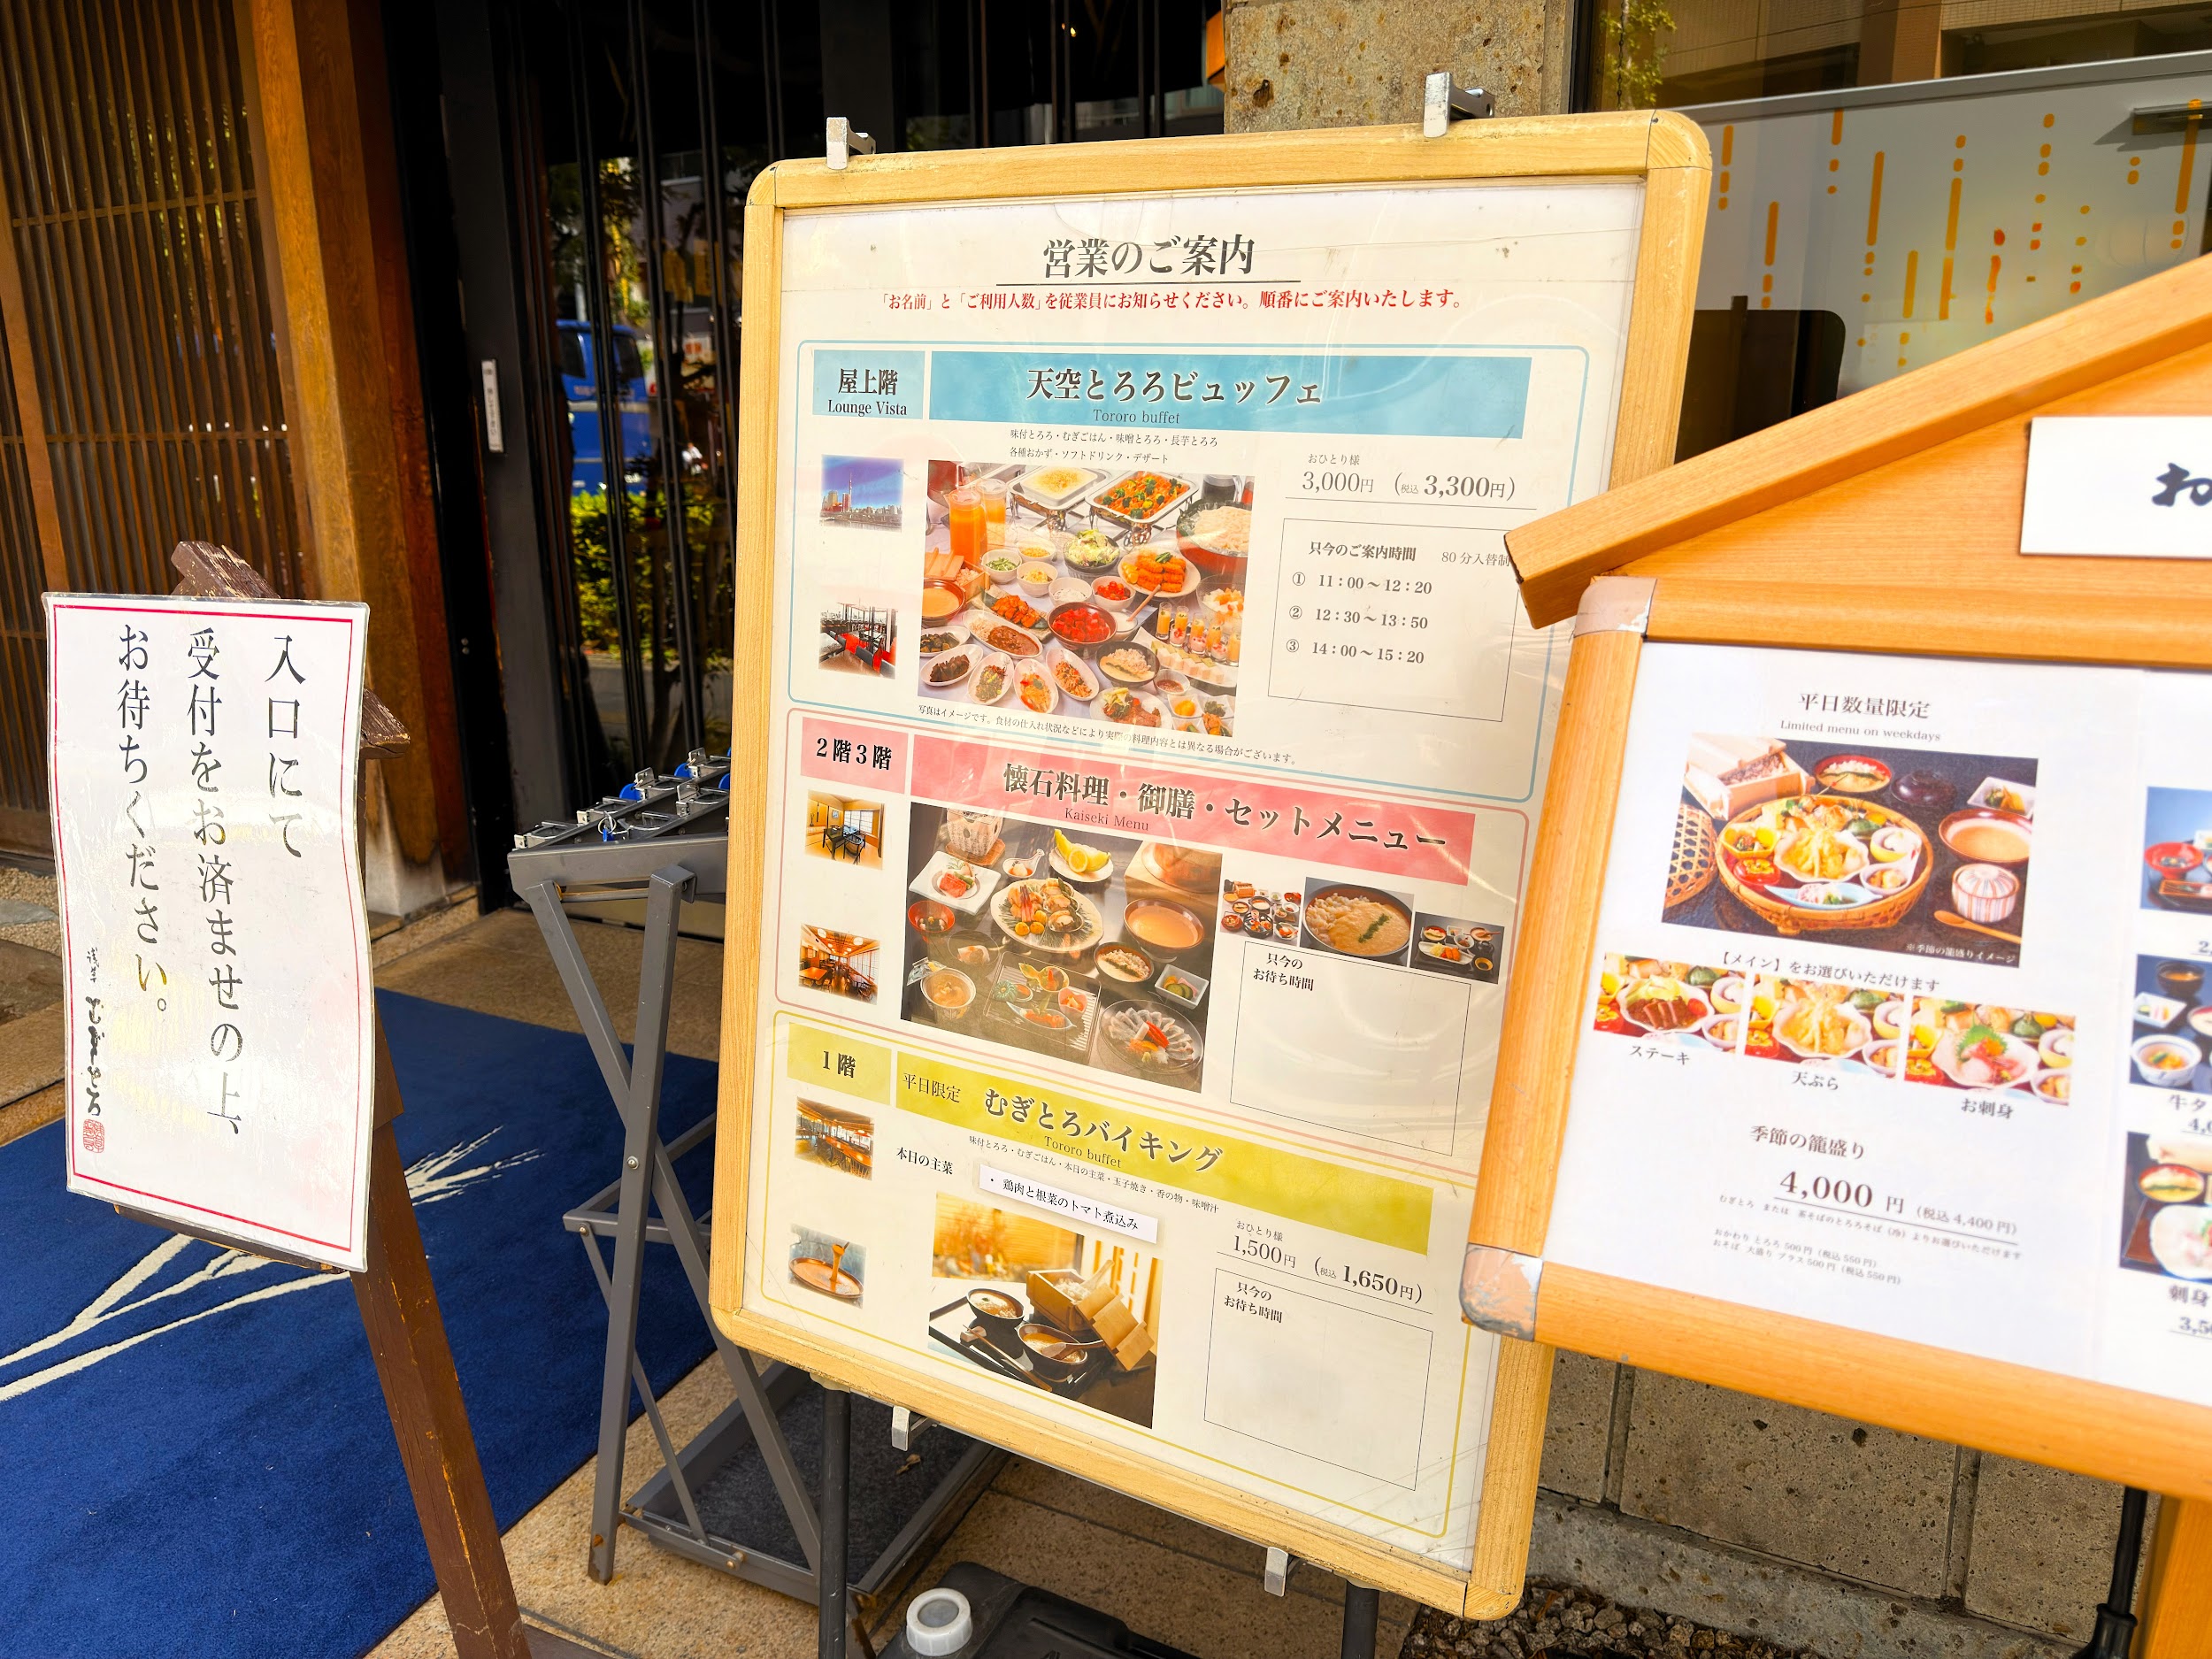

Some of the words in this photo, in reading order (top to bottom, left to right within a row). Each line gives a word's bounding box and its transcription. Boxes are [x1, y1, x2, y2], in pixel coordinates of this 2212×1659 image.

[1043, 234, 1255, 278] 営業のご案内
[838, 368, 898, 396] 屋上階
[1026, 367, 1321, 405] 天空とろろビュッフェ
[828, 400, 872, 417] Lounge
[876, 401, 907, 416] Vista
[1093, 409, 1137, 423] Tororo
[1141, 410, 1180, 425] buffet
[1308, 453, 1360, 465] おひとり様
[1302, 471, 1374, 493] 3,000円
[1309, 541, 1417, 561] 只今のご案内時間
[1798, 693, 1931, 718] 平日数量限定
[1780, 720, 1824, 732] Limited
[1827, 725, 1859, 735] menu
[1883, 728, 1941, 741] weekdays
[265, 634, 307, 858] 入口にて
[816, 737, 892, 771] 2階3階
[116, 624, 168, 1013] お待ちください。
[1003, 763, 1446, 850] 懐石料理・御膳・セットメニュー
[1064, 807, 1110, 826] Kaiseki
[1113, 816, 1149, 832] Menu
[186, 626, 243, 1135] 受付をお済ませの上、
[1266, 952, 1302, 970] 只今の
[1253, 968, 1314, 991] お待ち時間
[822, 1050, 856, 1079] 1階
[1630, 1044, 1691, 1065] ステーキ
[1791, 1071, 1839, 1090] 天ぷら
[902, 1072, 961, 1104] 平日限定
[984, 1087, 1224, 1171] むぎとろバイキング
[1961, 1097, 2014, 1119] お刺身
[1044, 1135, 1083, 1157] Tororo
[1087, 1148, 1122, 1169] buffet
[1749, 1125, 1865, 1160] 季節の籠盛り
[896, 1146, 954, 1176] 本日の主菜
[1779, 1171, 1874, 1208] 4,000
[1236, 1220, 1283, 1241] おひとり様
[1233, 1235, 1296, 1269] 1,500円
[1236, 1281, 1272, 1301] 只今の
[1224, 1294, 1283, 1324] お待ち時間
